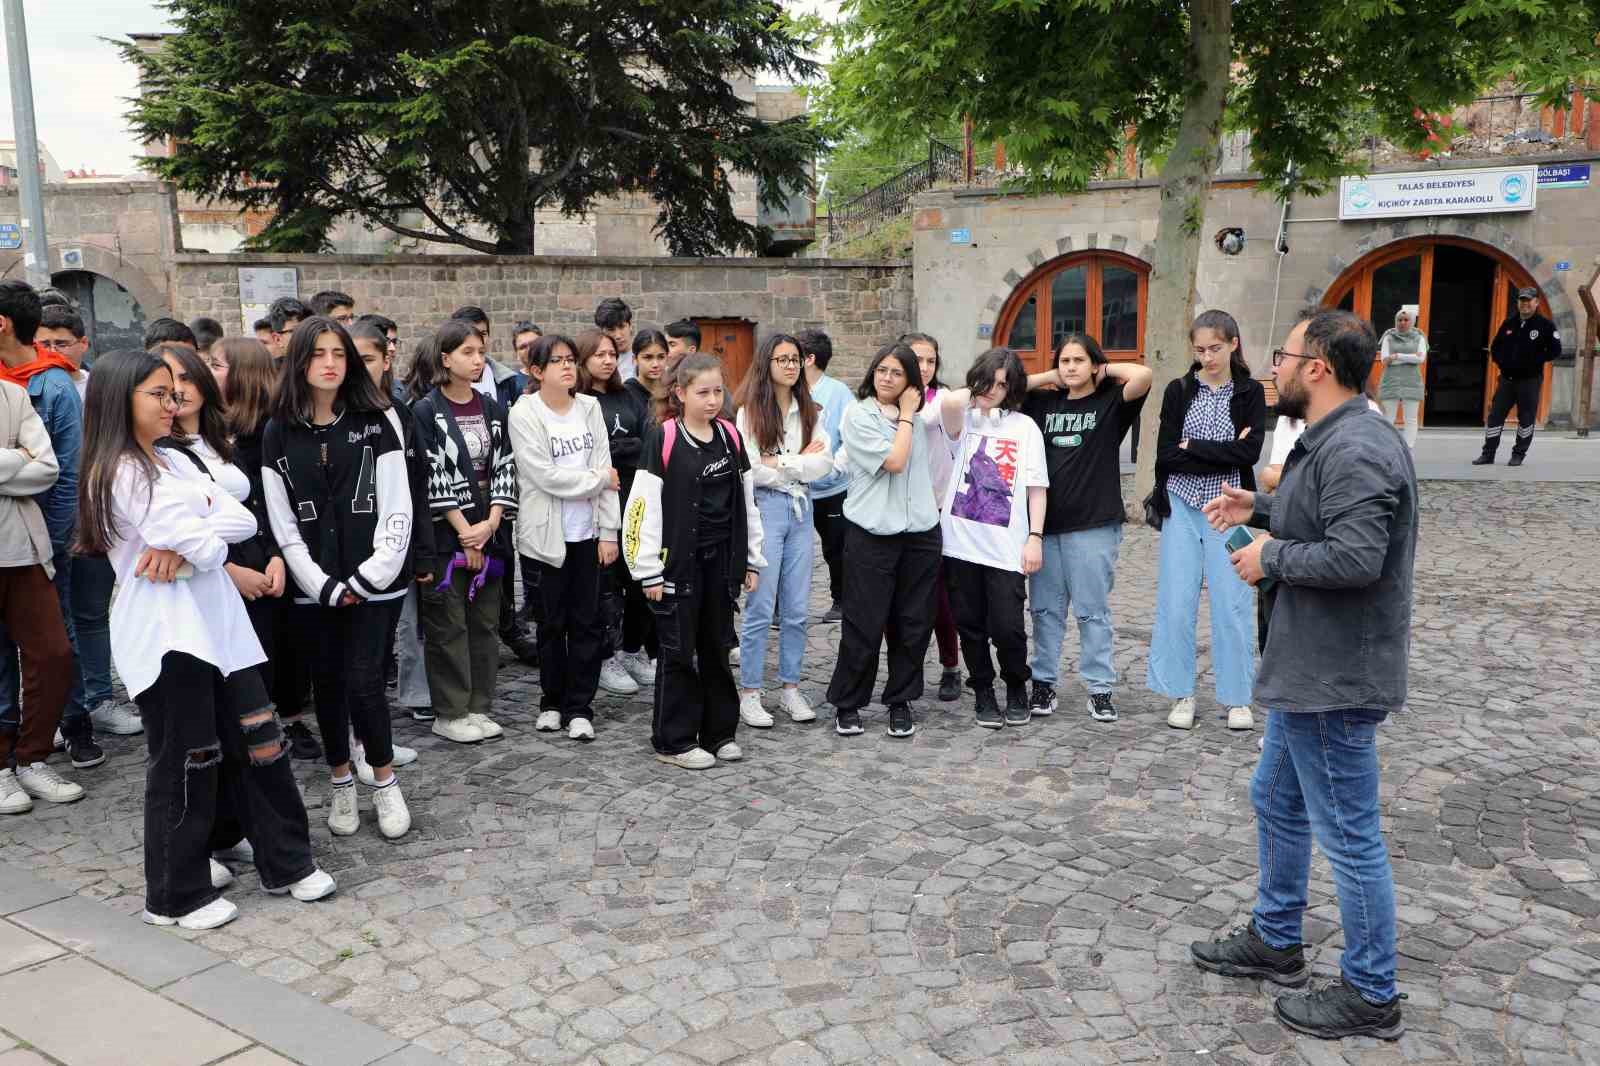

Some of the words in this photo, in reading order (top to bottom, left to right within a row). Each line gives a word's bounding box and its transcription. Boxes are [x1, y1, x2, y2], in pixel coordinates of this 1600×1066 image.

[1397, 183, 1424, 191] TALAS
[1413, 198, 1443, 206] ZABITA
[1445, 195, 1494, 205] KARAKOLU
